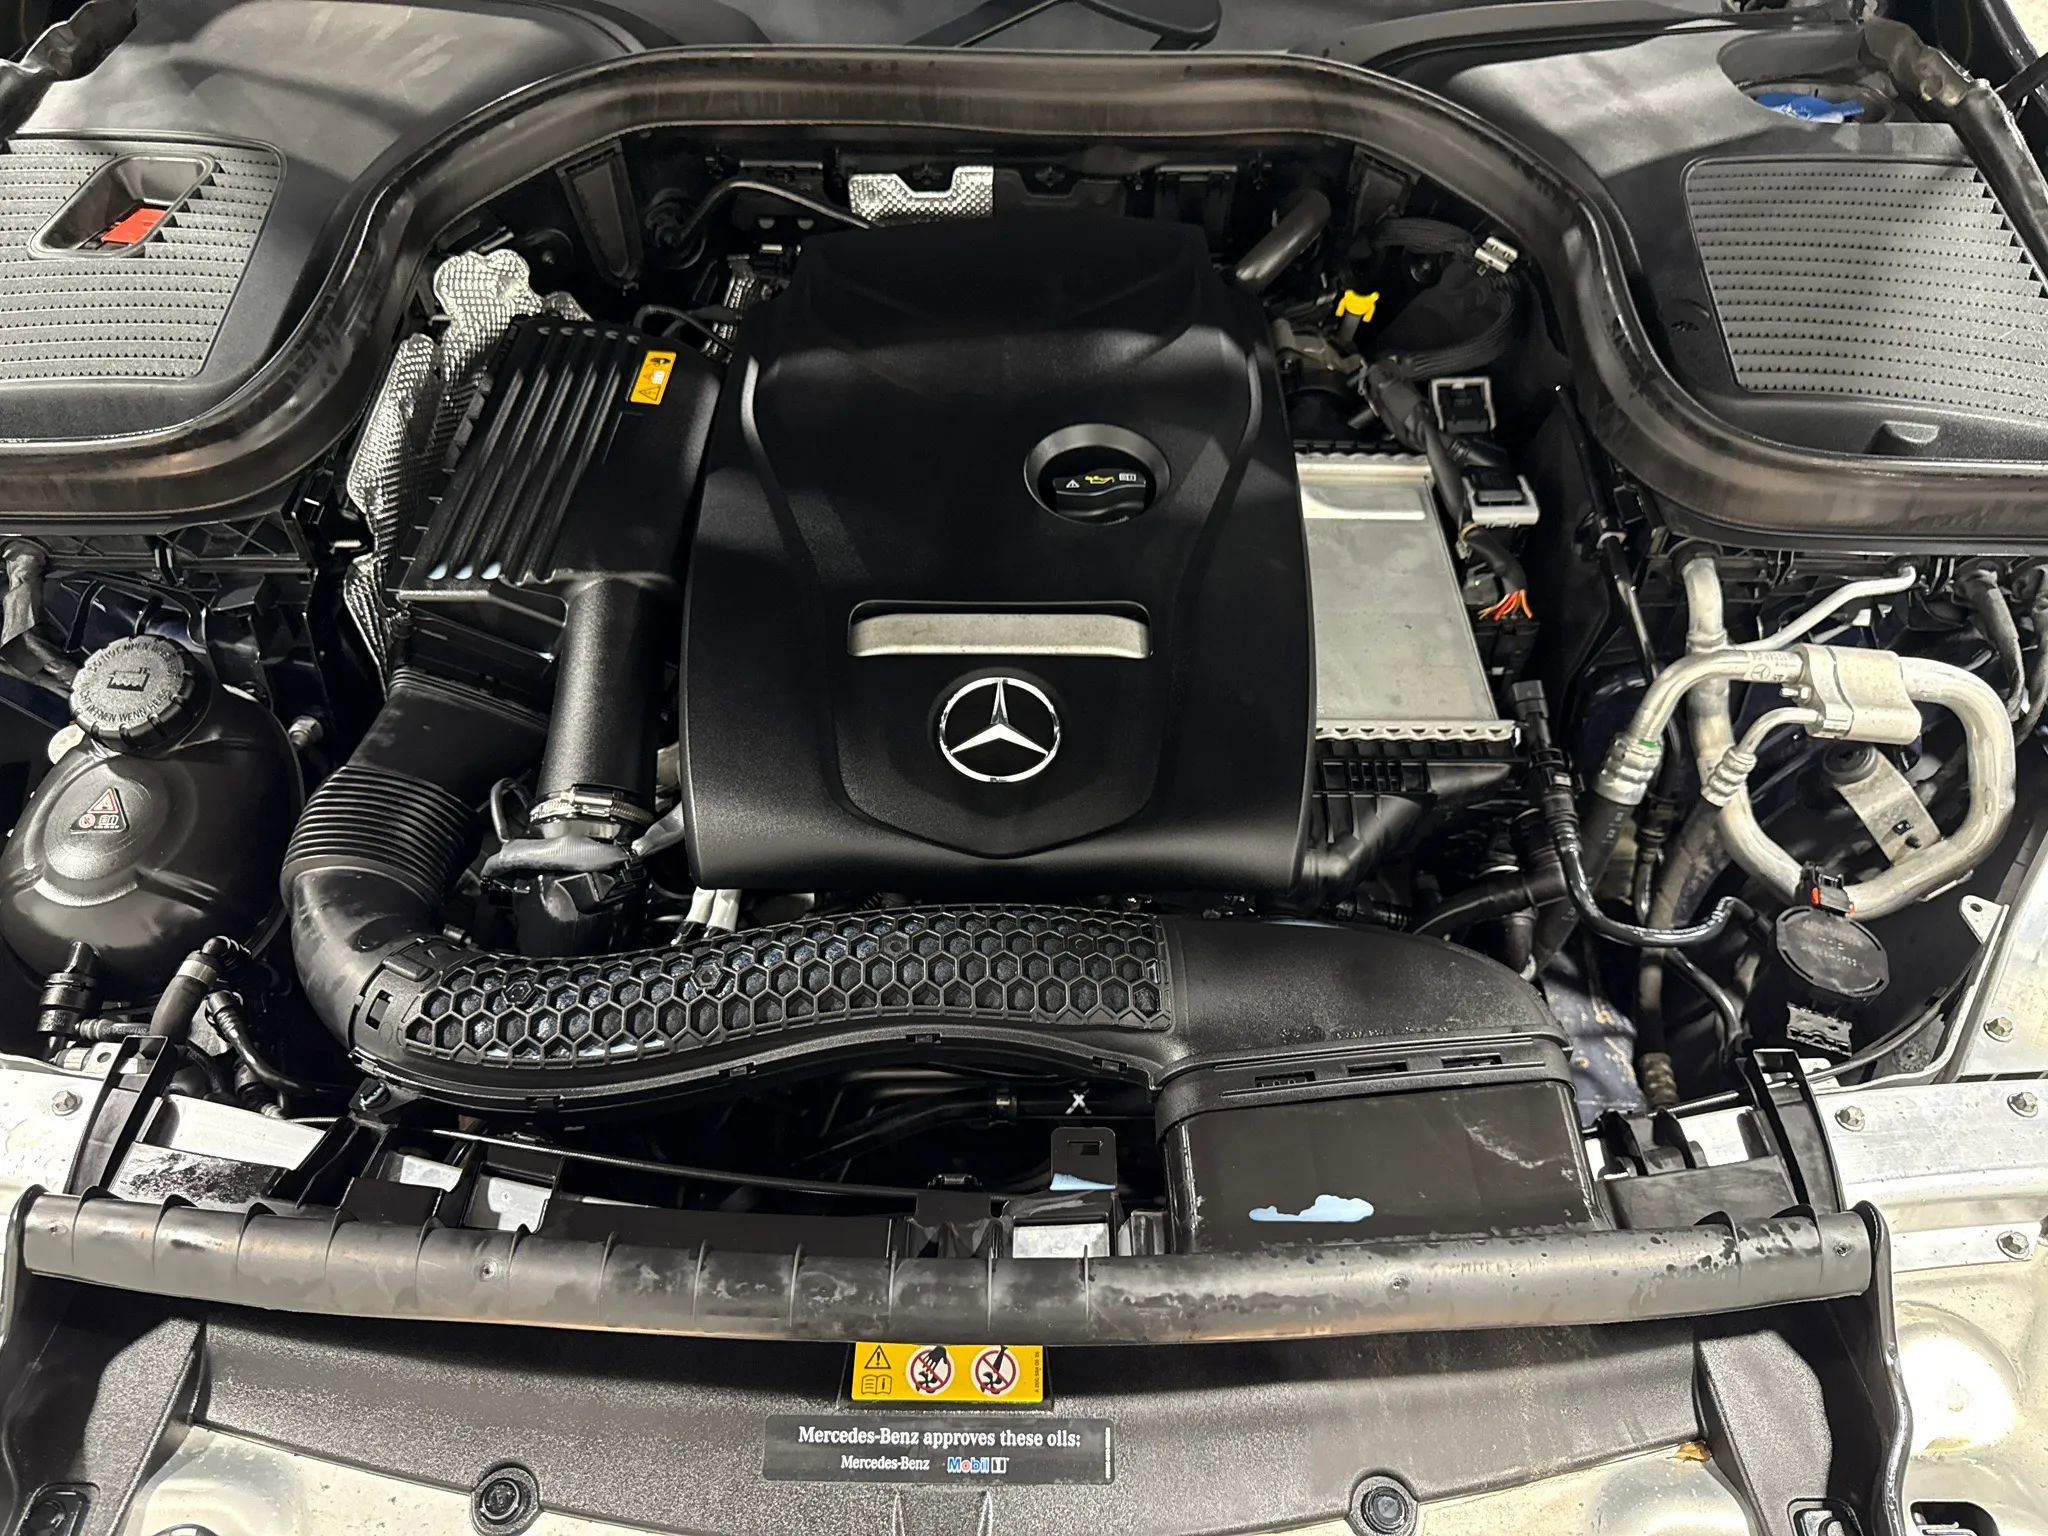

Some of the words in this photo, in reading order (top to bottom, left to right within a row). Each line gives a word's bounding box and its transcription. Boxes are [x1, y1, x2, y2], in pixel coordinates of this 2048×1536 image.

[118, 707, 148, 723] WENN
[798, 1426, 920, 1446] Mercedes-Benz
[923, 1430, 995, 1450] approves
[1000, 1429, 1043, 1447] these
[1047, 1430, 1081, 1448] oils:
[840, 1455, 930, 1471] Mercedes-Benz
[946, 1456, 989, 1474] Mobil
